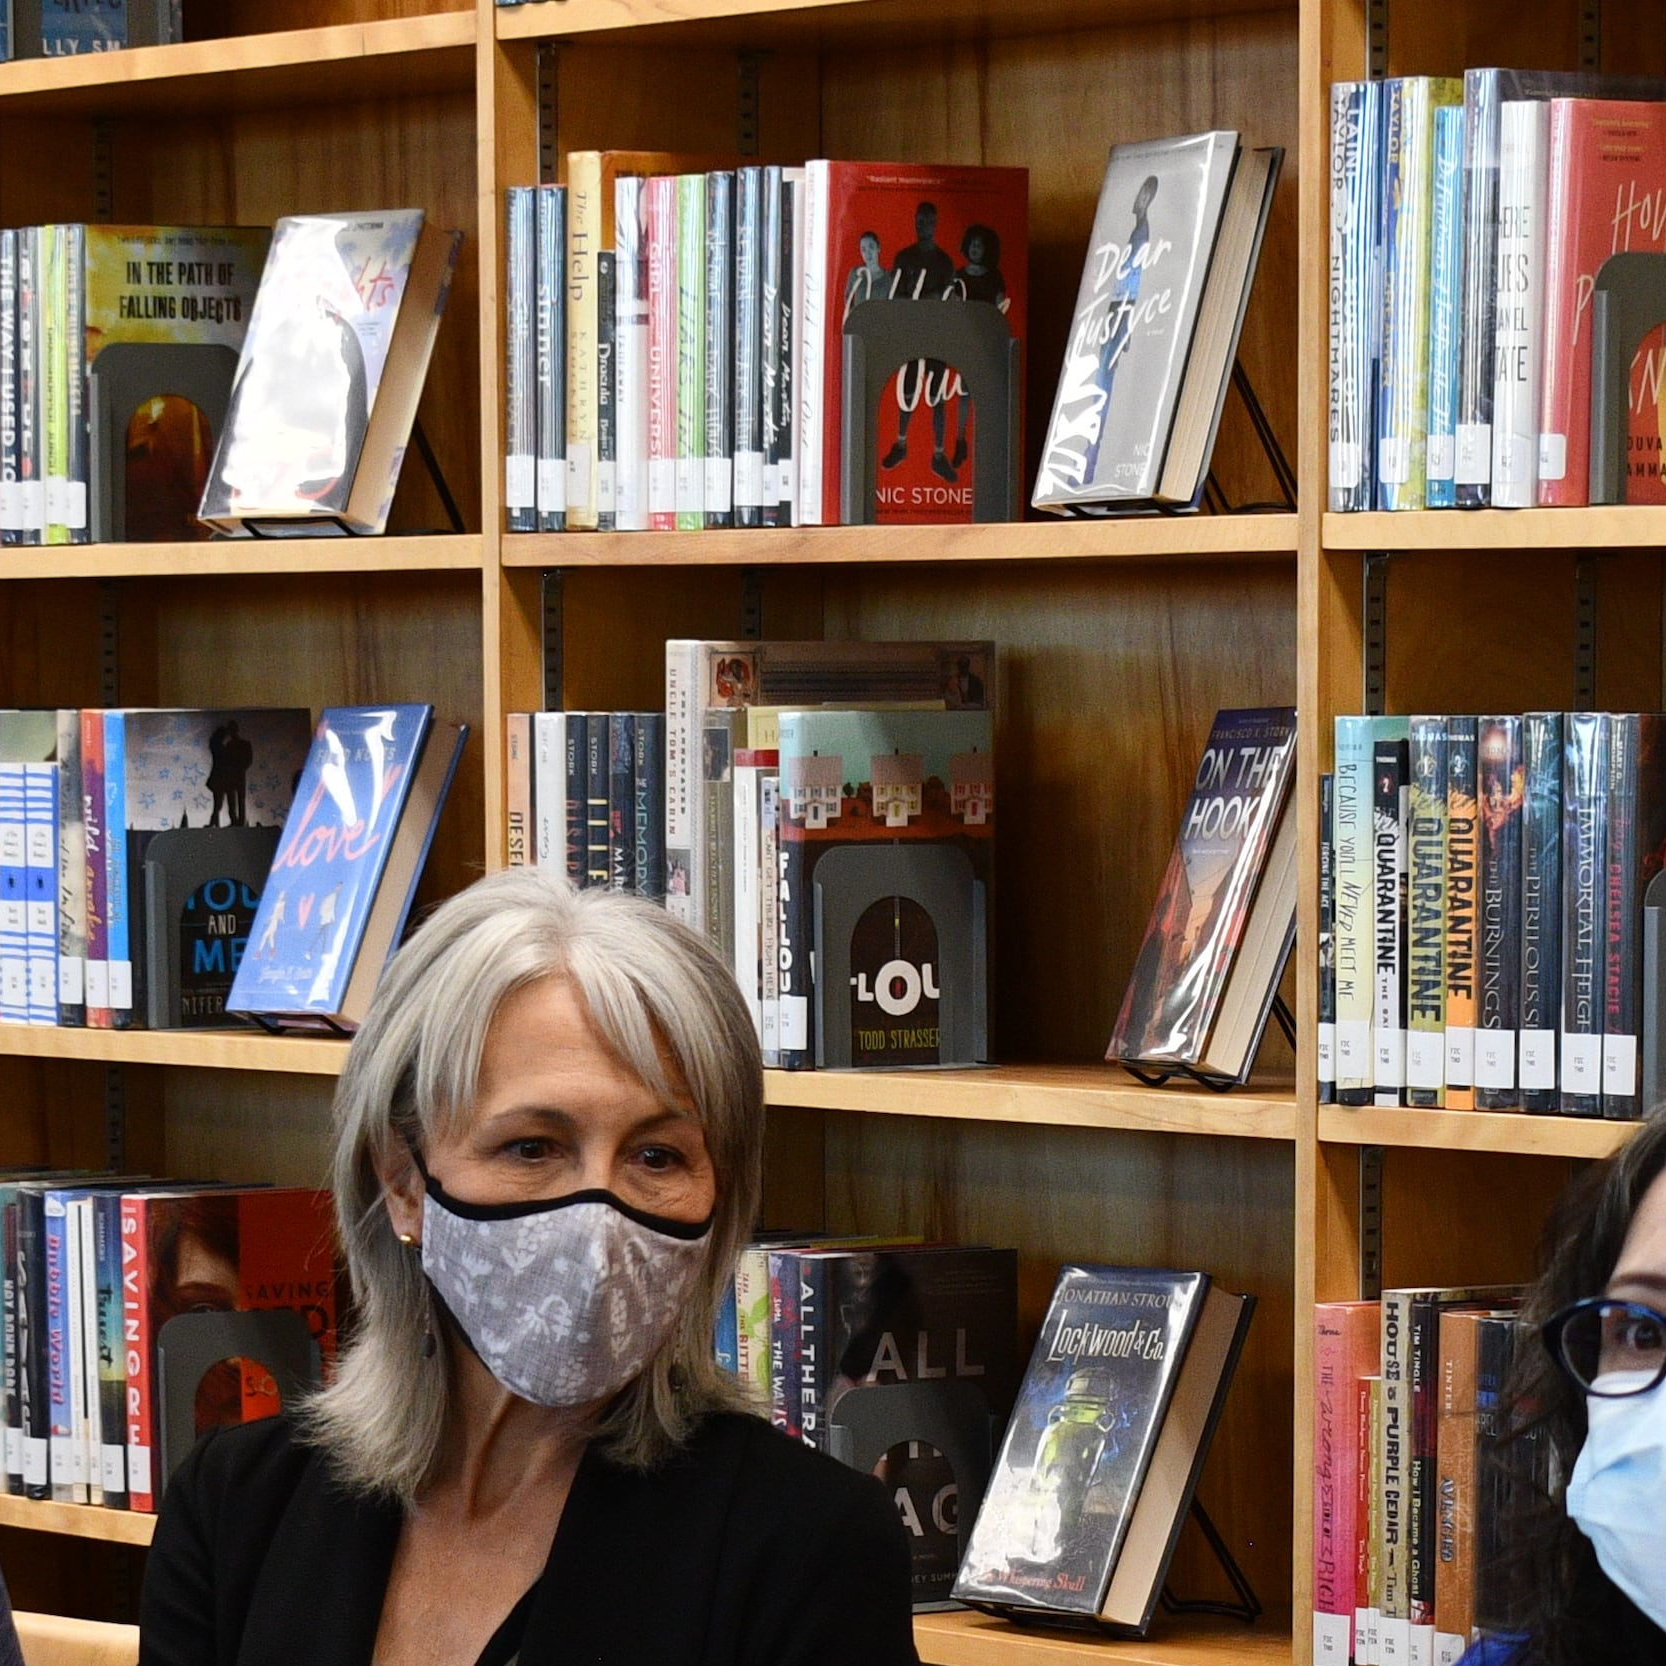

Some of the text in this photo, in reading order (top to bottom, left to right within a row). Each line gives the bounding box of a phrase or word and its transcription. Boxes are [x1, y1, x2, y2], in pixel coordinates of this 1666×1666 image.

[1332, 95, 1345, 191] TAYLOR
[1387, 90, 1399, 164] TAYLOR
[126, 261, 234, 286] IN THE PATH OF
[568, 191, 590, 302] The Help
[1093, 238, 1172, 293] Dear
[119, 295, 243, 324] FALLING OBJECTS
[781, 302, 791, 354] Dear
[1064, 288, 1173, 370] Justyce
[0, 257, 16, 483] THE WAY USED TO
[597, 342, 612, 406] Dracula
[1329, 256, 1341, 443] NIGHTMARES
[578, 330, 588, 441] KATHRYN
[911, 486, 973, 505] STONE
[567, 738, 575, 776] STORK
[590, 736, 598, 775] STORK
[669, 668, 677, 836] UNCLE TOM'S CABIN
[1195, 745, 1288, 791] ON THE
[1412, 732, 1450, 742] THOMAS
[83, 794, 100, 857] wild
[270, 774, 380, 872] love
[636, 728, 647, 895] STORK MEMORY
[1184, 795, 1261, 841] HOOK
[1337, 763, 1358, 830] BECAUSE
[1320, 841, 1330, 909] FORCING THE ACE
[1337, 880, 1362, 933] NEVER
[1446, 816, 1474, 1001] QUARANTINE
[1575, 806, 1594, 950] IMMORTAL
[208, 914, 237, 935] AND
[1375, 832, 1396, 1001] QUARANTINE THE
[1410, 816, 1443, 1023] QUARANTINE
[1523, 875, 1540, 1004] PERILOUS
[1607, 863, 1623, 1014] CHELSEA STACIE
[193, 938, 245, 974] ME
[1339, 936, 1358, 974] MEET
[1337, 979, 1355, 1001] ME
[858, 1029, 886, 1051] TODD
[47, 1233, 65, 1406] Bubble World
[122, 1216, 141, 1377] SAVING
[244, 1280, 330, 1301] SAVING
[1057, 1288, 1132, 1306] JONATHAN
[772, 1340, 783, 1370] THE
[866, 1327, 986, 1383] ALL
[1385, 1300, 1401, 1382] HOUSE
[1412, 1324, 1421, 1393] TIM TINGLE
[1317, 1365, 1335, 1484] THE wrong
[1385, 1406, 1400, 1485] PURPLE
[1384, 1490, 1402, 1545] CEDAR
[1411, 1460, 1421, 1596] How Became Ghost
[1053, 1572, 1087, 1592] Skull
